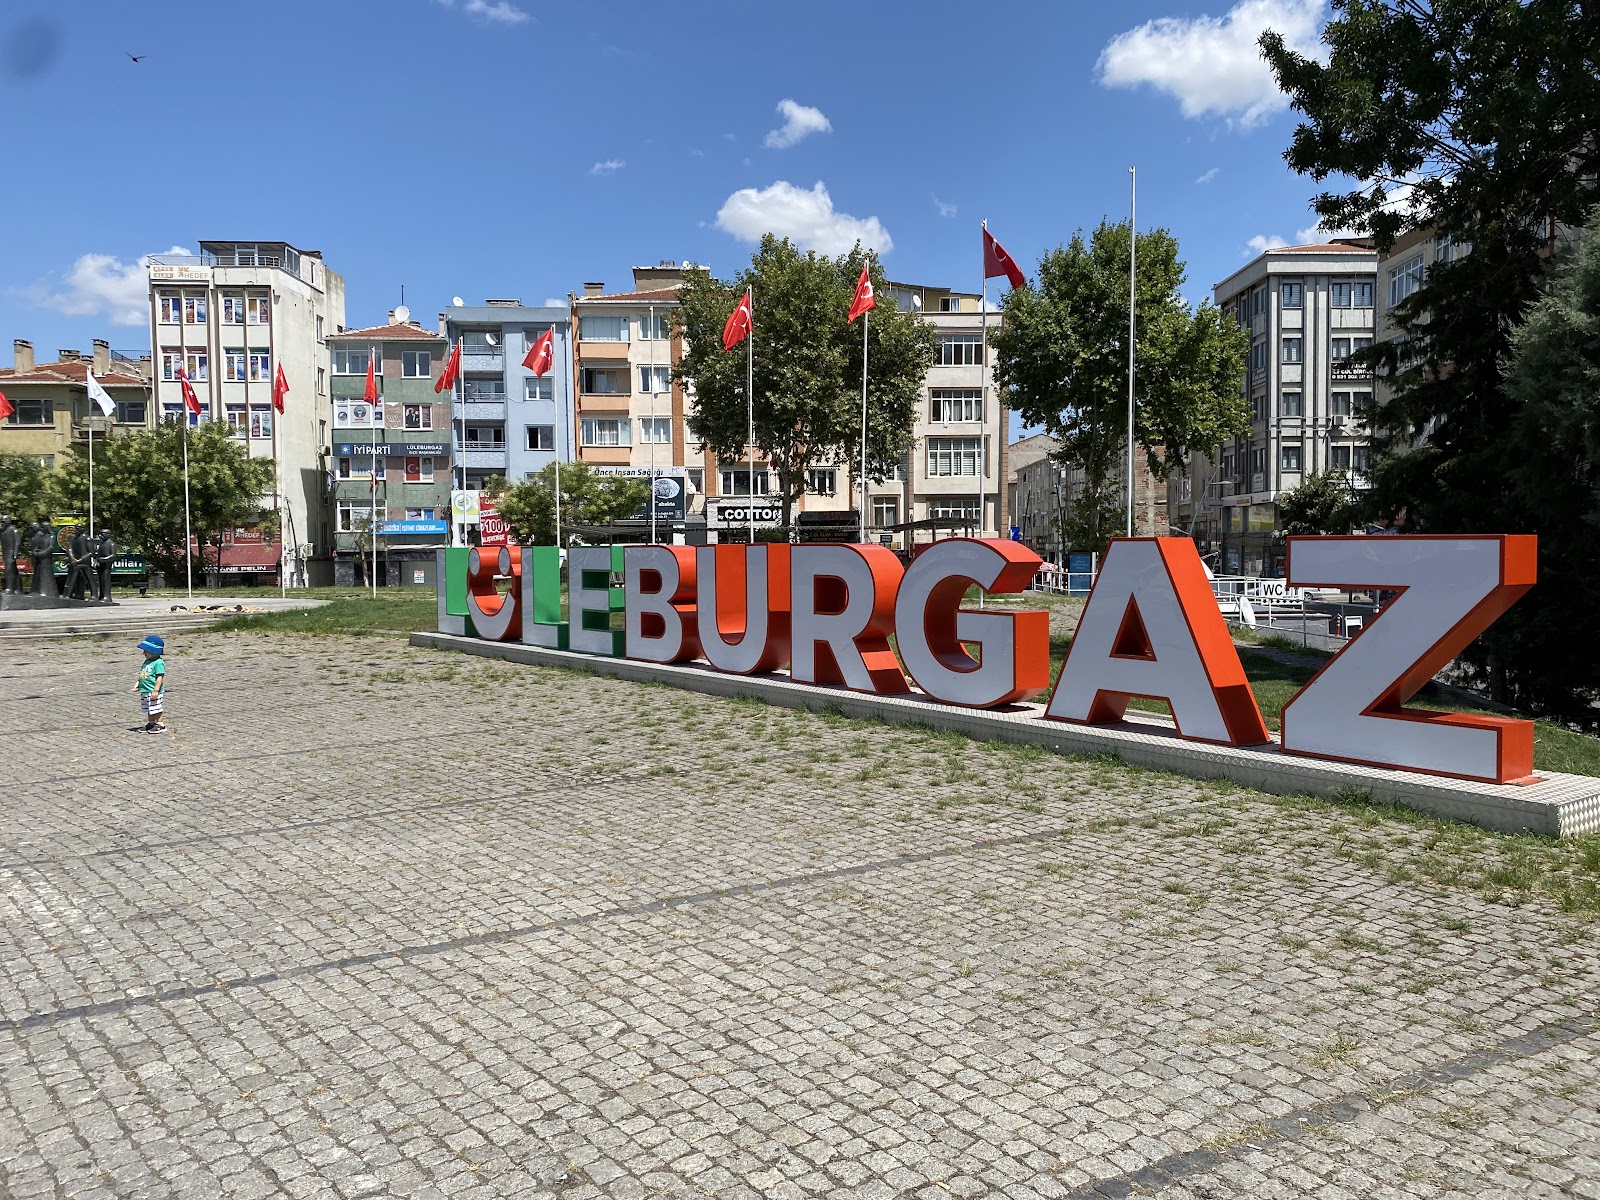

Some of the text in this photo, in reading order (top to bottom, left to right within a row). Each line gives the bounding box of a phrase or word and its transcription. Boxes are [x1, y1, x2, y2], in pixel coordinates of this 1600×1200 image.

[353, 444, 391, 455] İYİ PARTİ
[614, 467, 636, 476] İnsan
[724, 508, 783, 520] COTTON
[1263, 583, 1283, 596] WC
[437, 534, 1538, 786] LÜLEBURGAZ
